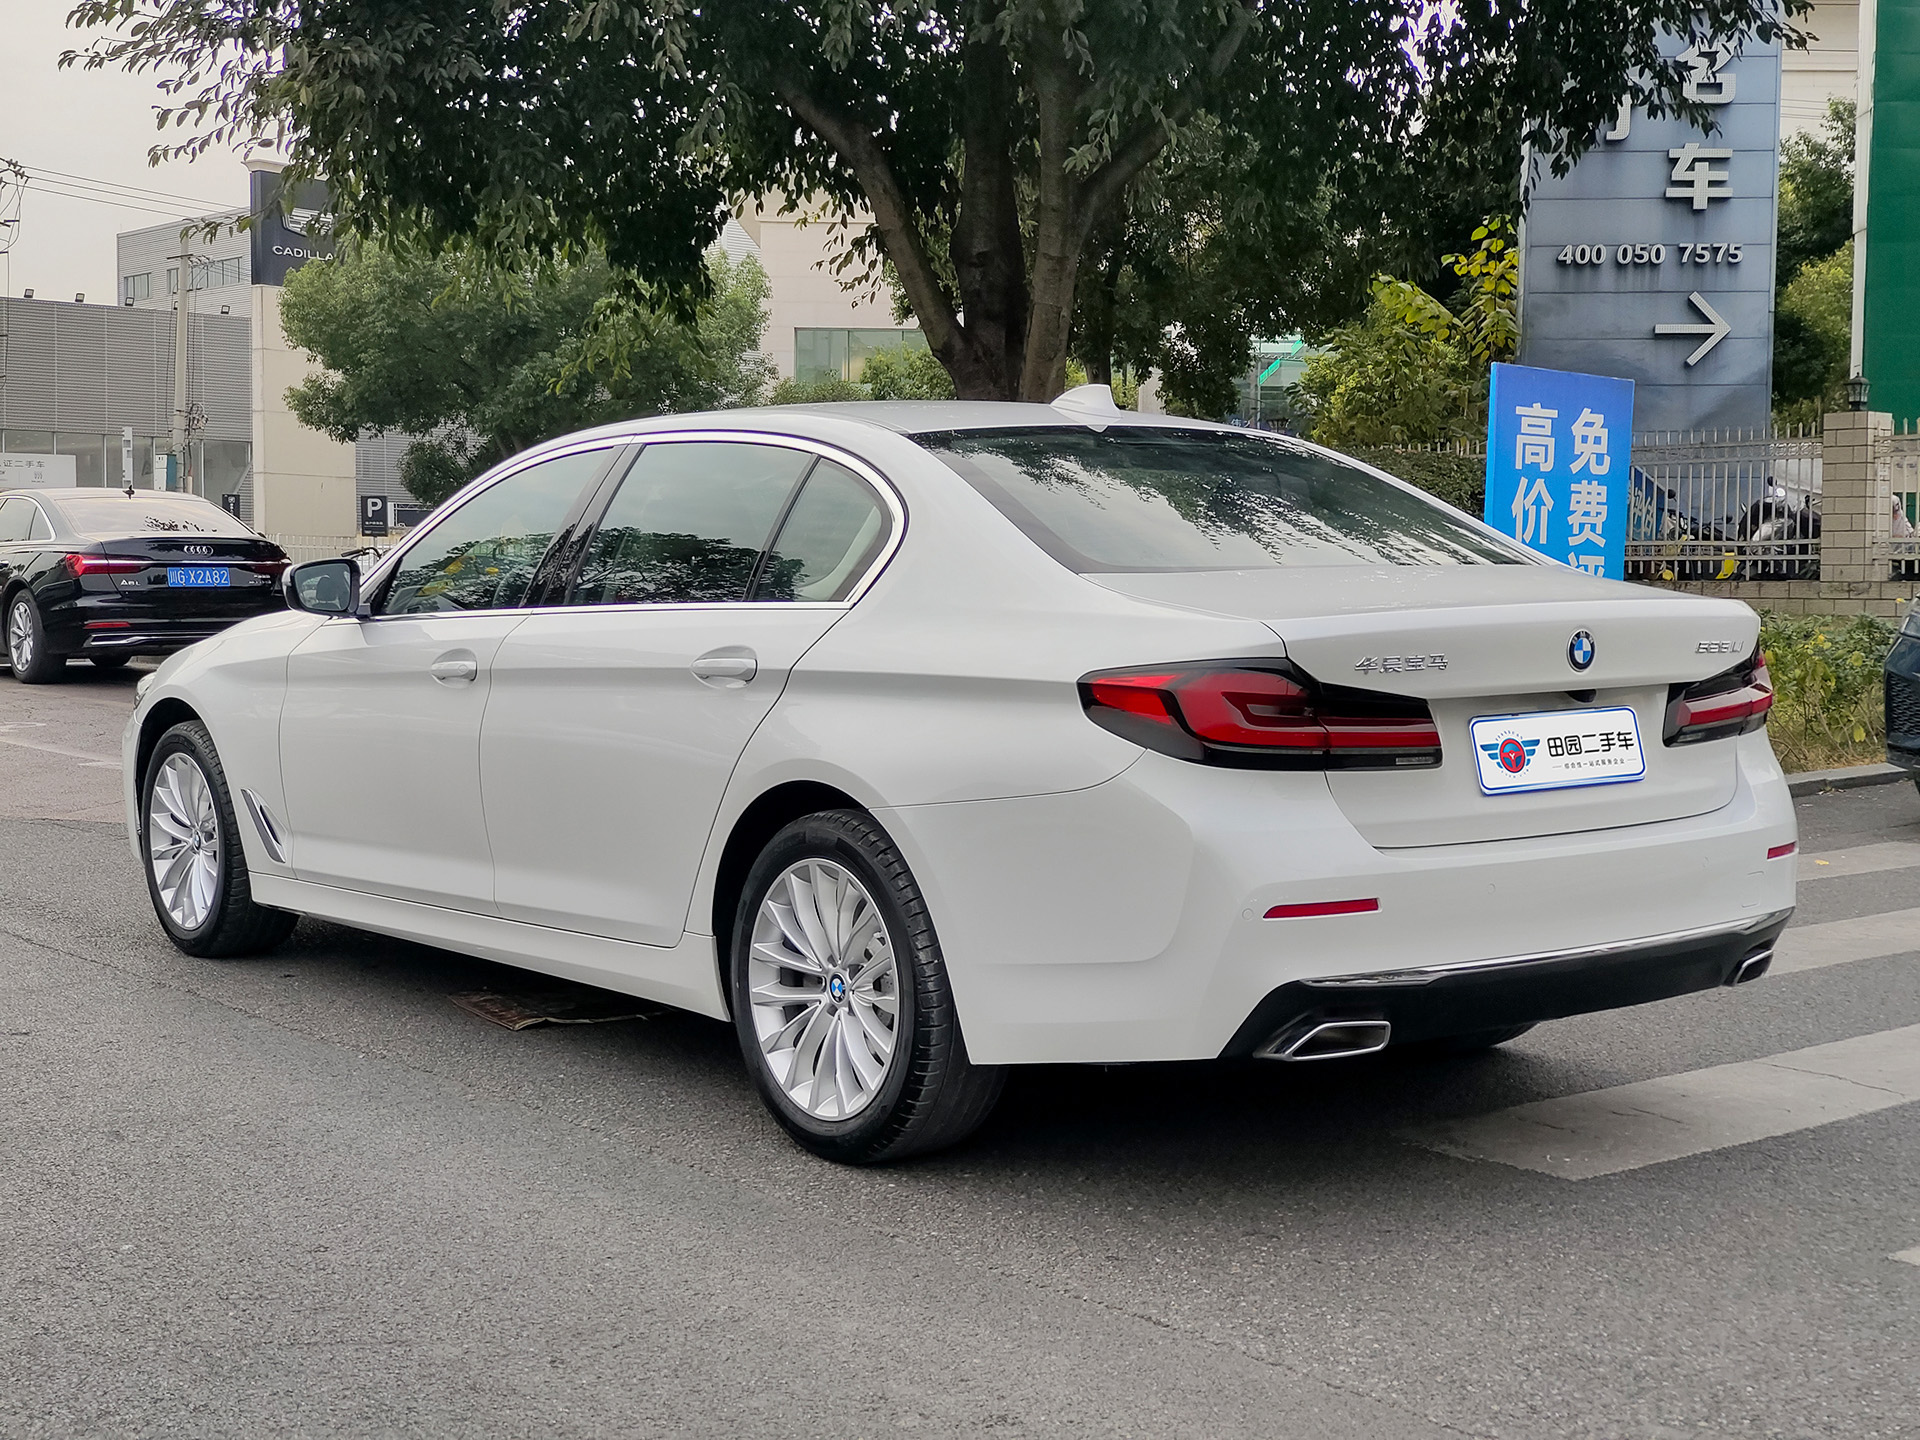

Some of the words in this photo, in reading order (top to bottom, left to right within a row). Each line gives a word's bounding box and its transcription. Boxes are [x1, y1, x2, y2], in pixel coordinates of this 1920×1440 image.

[272, 245, 334, 261] CADILLA
[1557, 244, 1607, 265] 400
[1616, 243, 1666, 265] 050
[1678, 242, 1744, 264] 7575
[0, 459, 45, 468] 证二手车
[1511, 402, 1558, 544] 高价
[367, 498, 382, 518] P
[1354, 653, 1449, 675] 华晨宝马
[1547, 731, 1635, 757] 田园二手车
